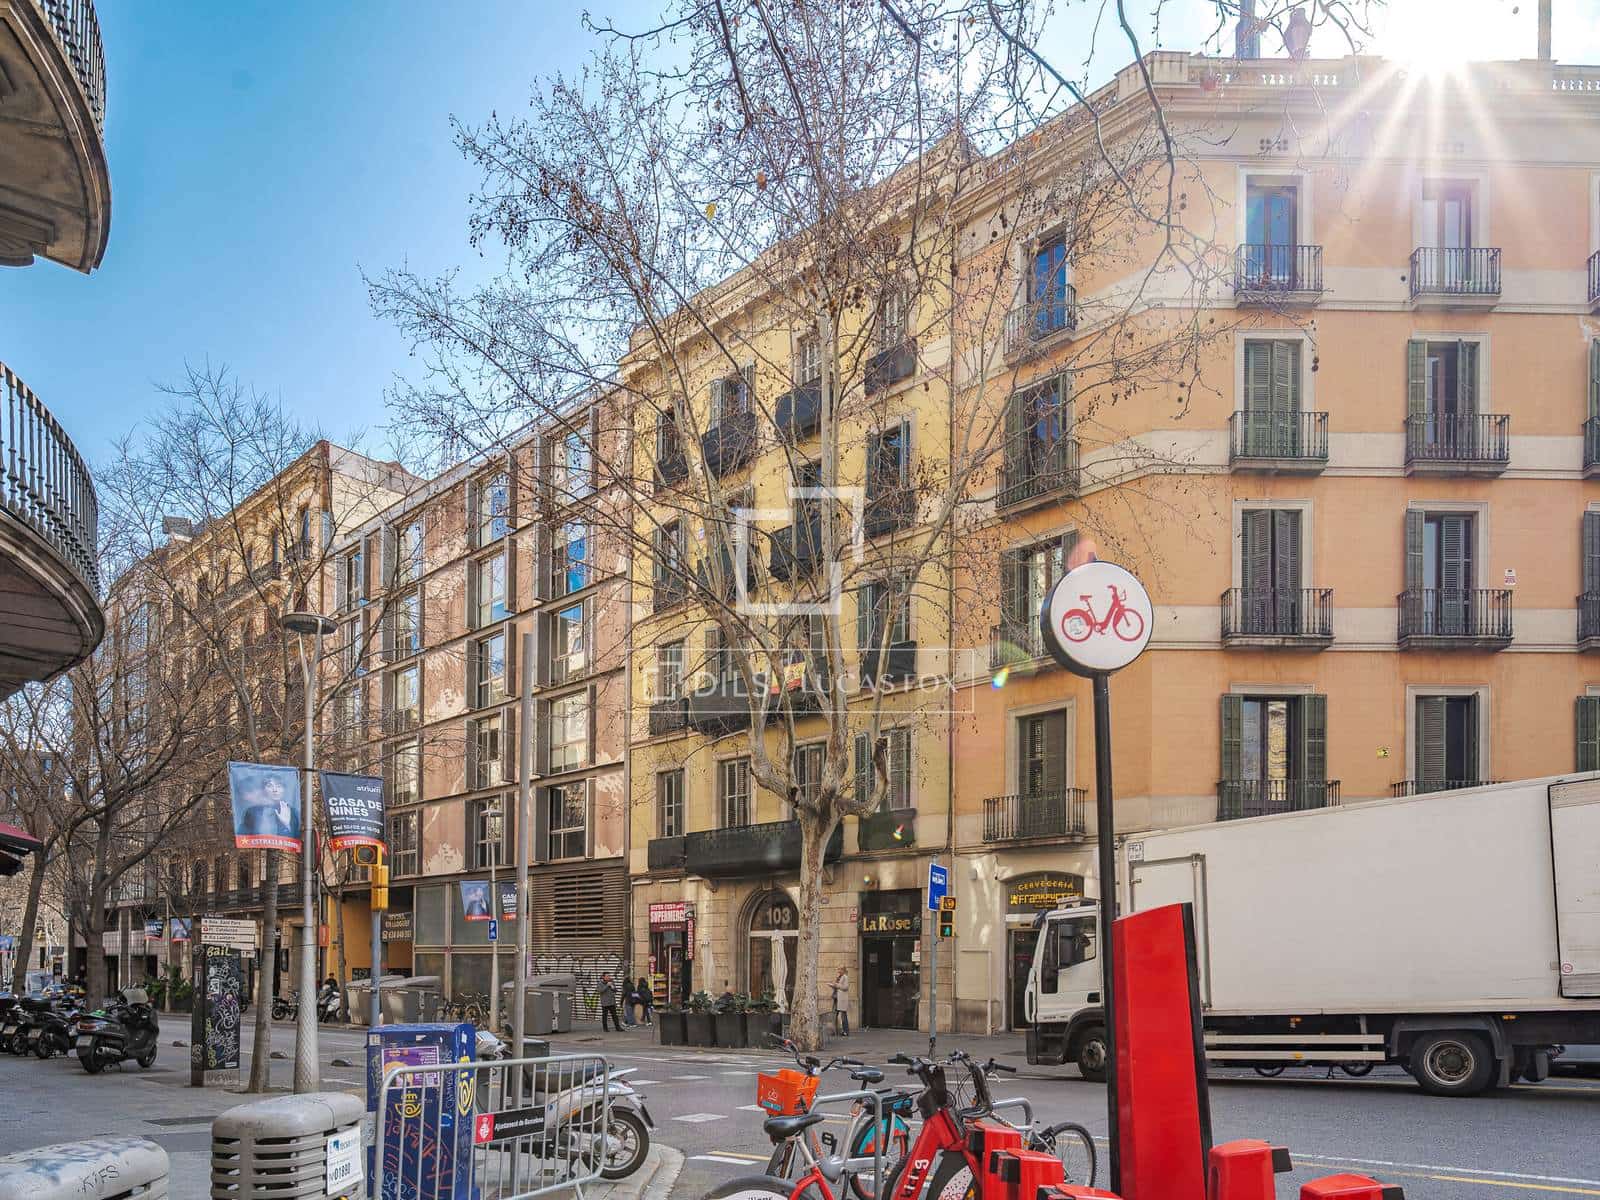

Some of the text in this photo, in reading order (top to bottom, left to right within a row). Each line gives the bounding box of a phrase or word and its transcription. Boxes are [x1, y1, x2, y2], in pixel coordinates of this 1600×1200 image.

[328, 797, 383, 812] CASA DE
[329, 806, 369, 817] NINES
[768, 906, 791, 925] 103
[863, 915, 911, 932] La Rose
[494, 1120, 519, 1131] Ajuntament
